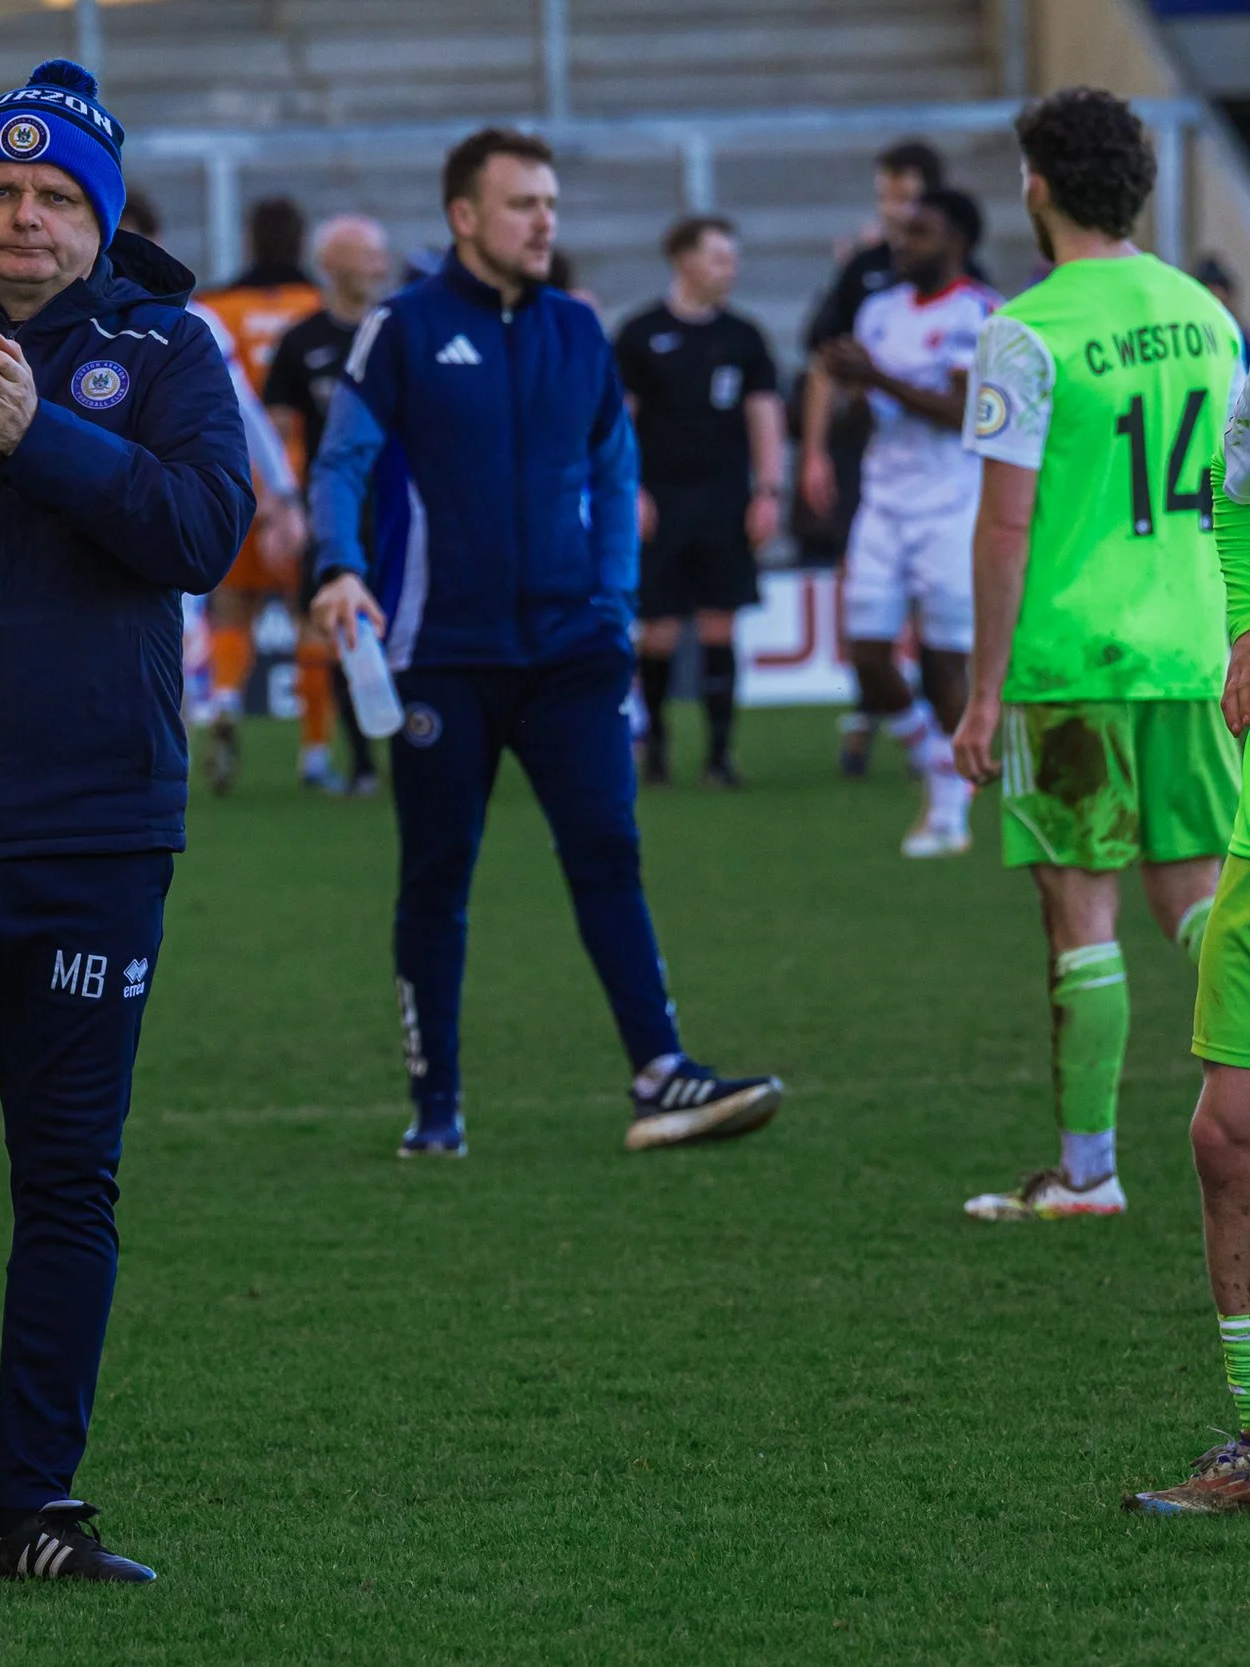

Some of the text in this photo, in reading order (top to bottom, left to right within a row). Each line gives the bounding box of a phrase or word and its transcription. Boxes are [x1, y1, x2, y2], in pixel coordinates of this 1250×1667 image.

[1111, 321, 1219, 368] WESTON
[1116, 389, 1214, 536] 14
[51, 949, 107, 998] MB
